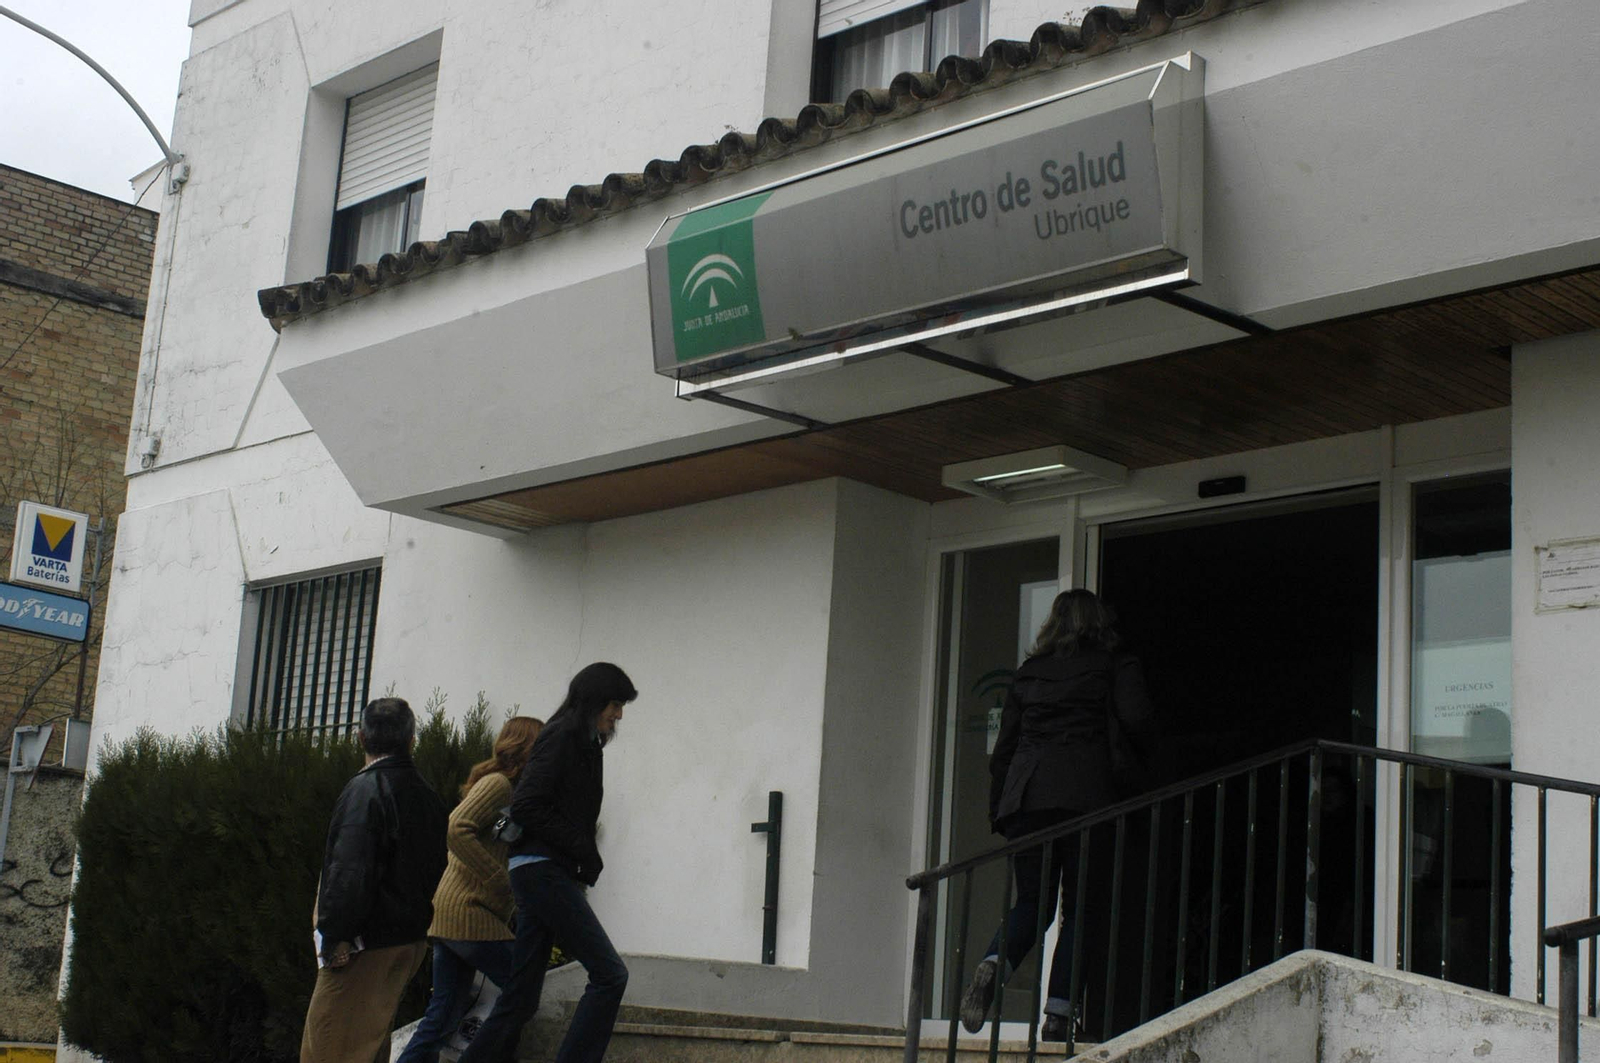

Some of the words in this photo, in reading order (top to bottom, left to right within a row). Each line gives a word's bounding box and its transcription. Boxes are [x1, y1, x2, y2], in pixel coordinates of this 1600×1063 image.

[900, 188, 987, 239] Centro
[996, 171, 1032, 213] de
[1040, 140, 1127, 201] Salud
[1033, 197, 1131, 241] Ubrique
[683, 317, 704, 332] JUNTA
[704, 314, 713, 326] DE
[33, 556, 67, 573] VARTA
[27, 566, 70, 584] Baterías
[1445, 681, 1494, 693] URGENCIAS
